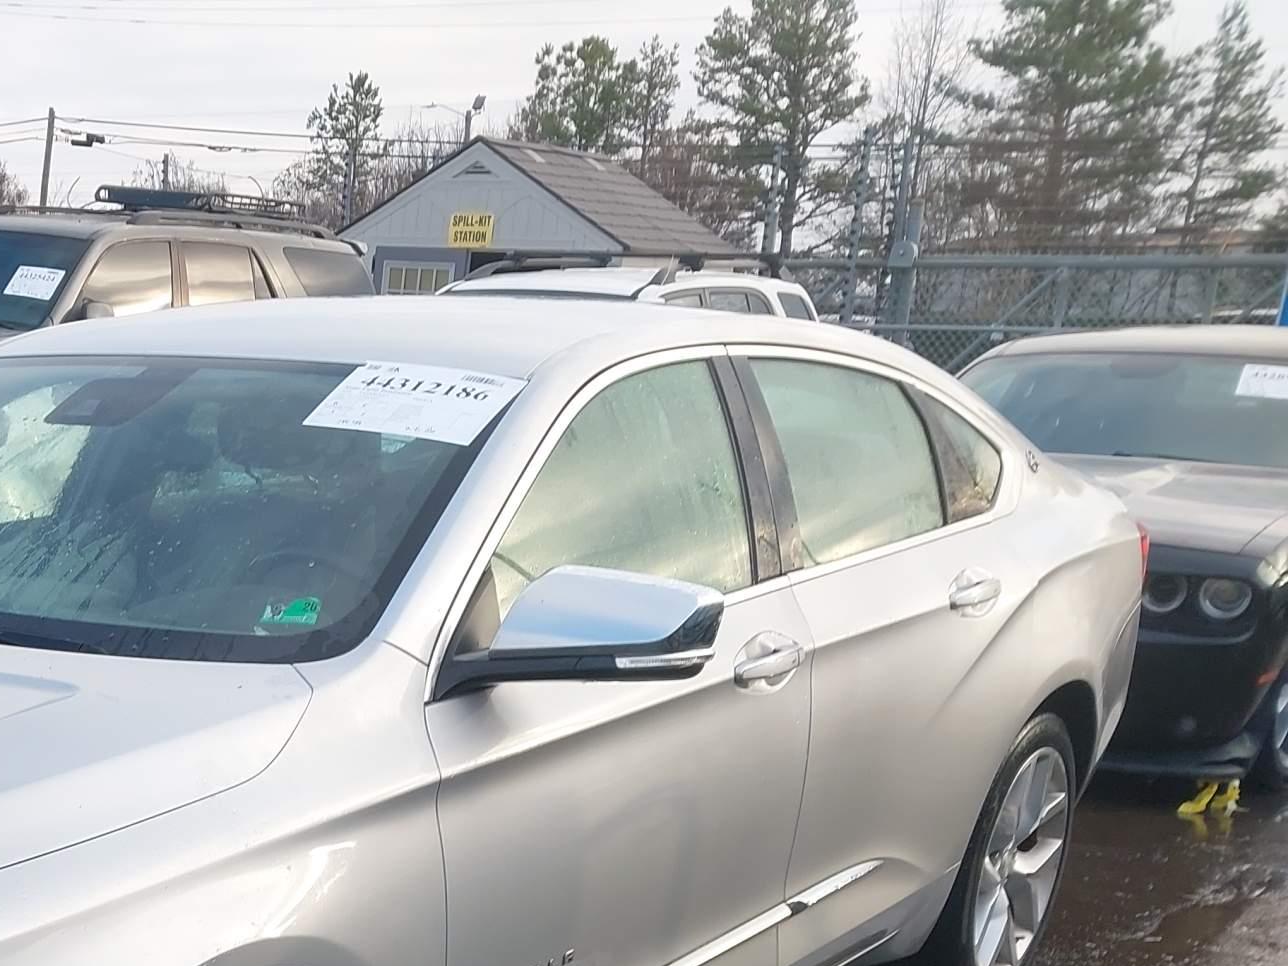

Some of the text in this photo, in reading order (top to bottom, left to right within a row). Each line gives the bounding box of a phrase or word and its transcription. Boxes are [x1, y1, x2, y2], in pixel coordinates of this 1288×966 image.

[452, 215, 492, 227] SPILL-KIT
[453, 230, 487, 243] STATION
[361, 374, 489, 401] 44312186
